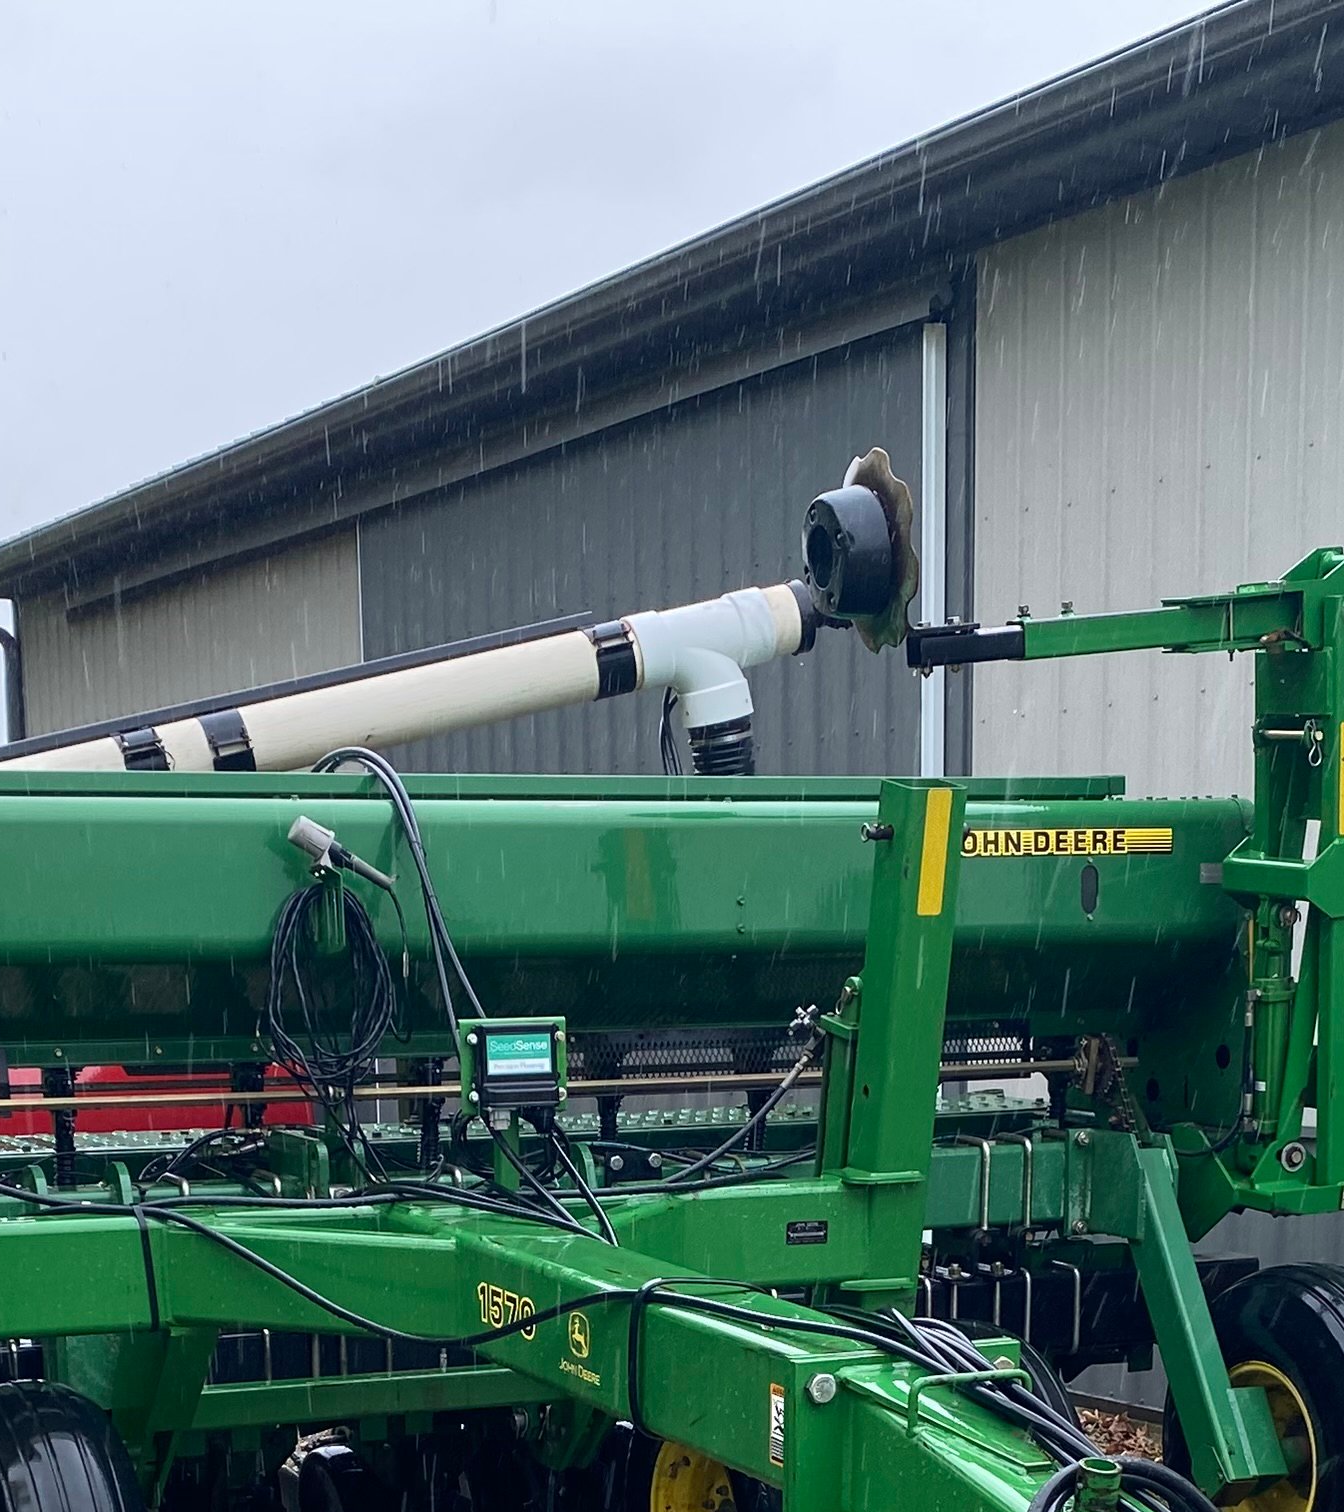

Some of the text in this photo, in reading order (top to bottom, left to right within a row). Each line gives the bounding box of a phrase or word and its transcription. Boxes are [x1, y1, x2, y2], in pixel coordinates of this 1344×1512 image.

[961, 830, 1127, 856] OHN DEERE
[489, 1040, 548, 1052] SeedSense
[477, 1281, 536, 1340] 1570
